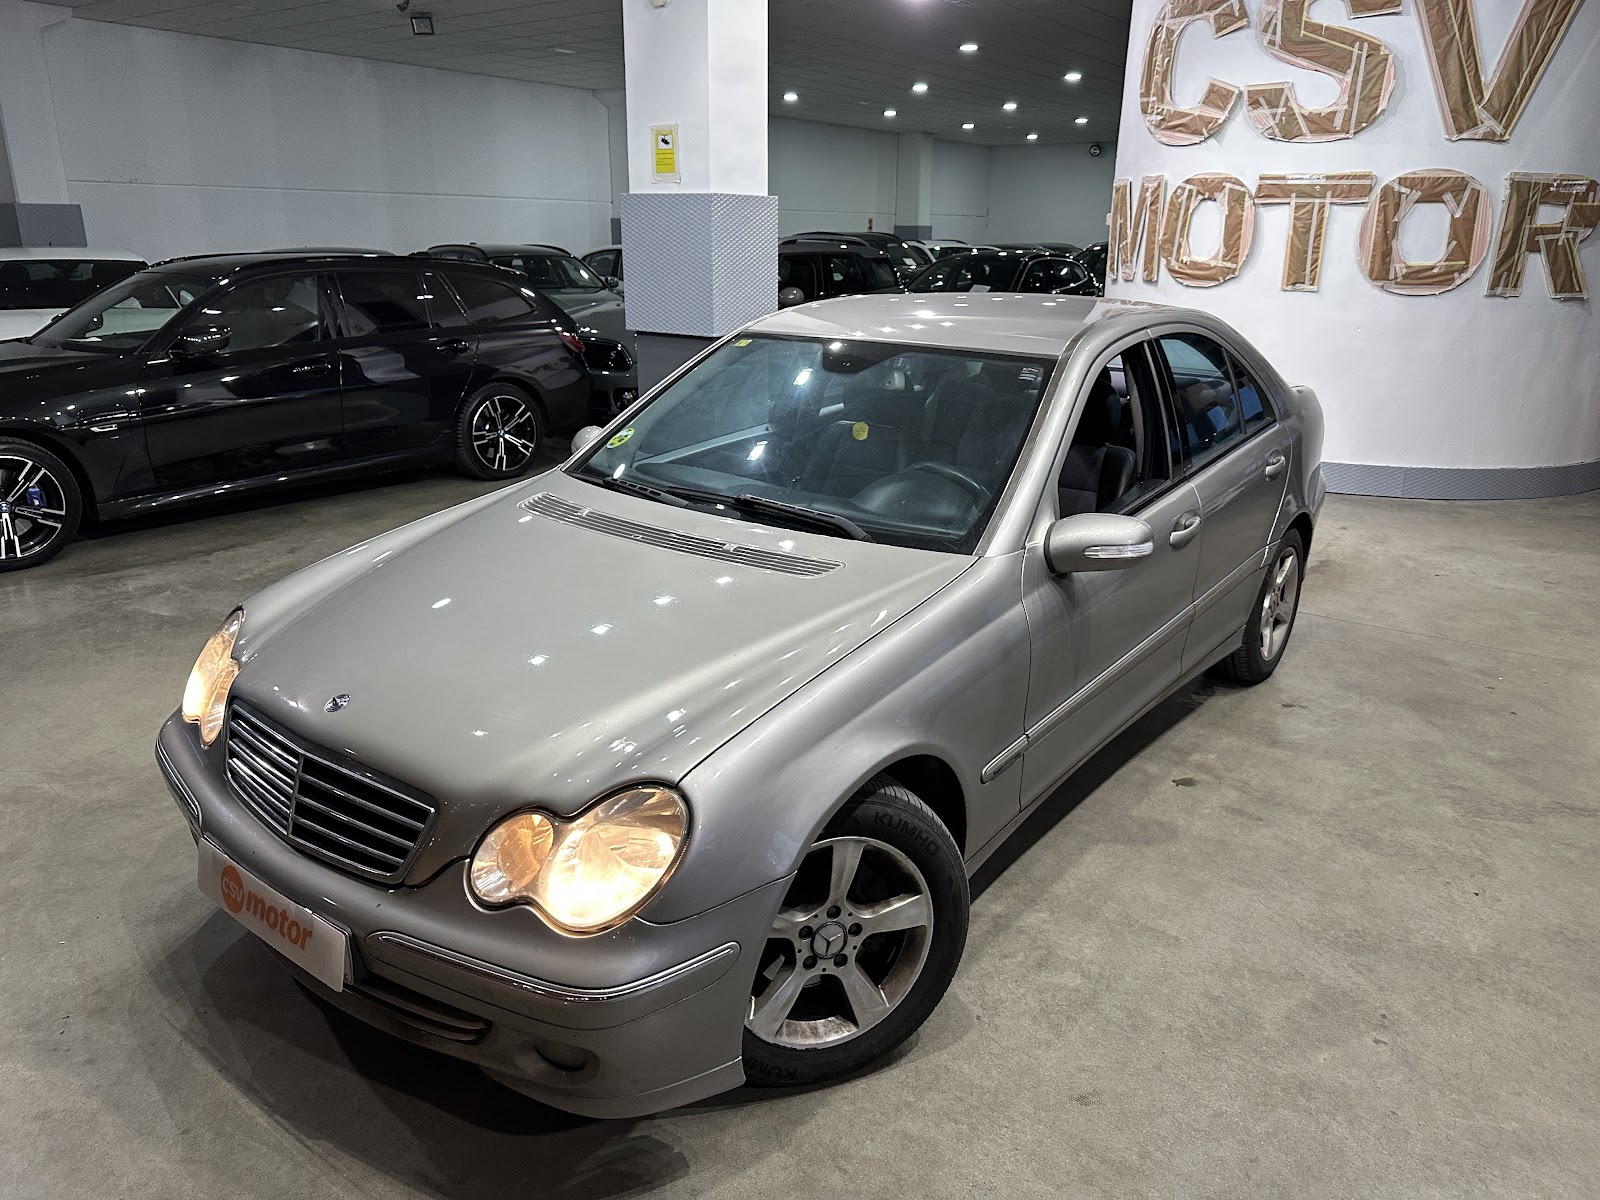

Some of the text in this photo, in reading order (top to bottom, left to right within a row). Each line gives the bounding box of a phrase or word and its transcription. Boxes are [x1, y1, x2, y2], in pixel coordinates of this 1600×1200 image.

[1139, 0, 1581, 146] CSV
[1107, 168, 1600, 300] MOTOR
[873, 811, 939, 856] KUMHO
[245, 890, 313, 951] motor
